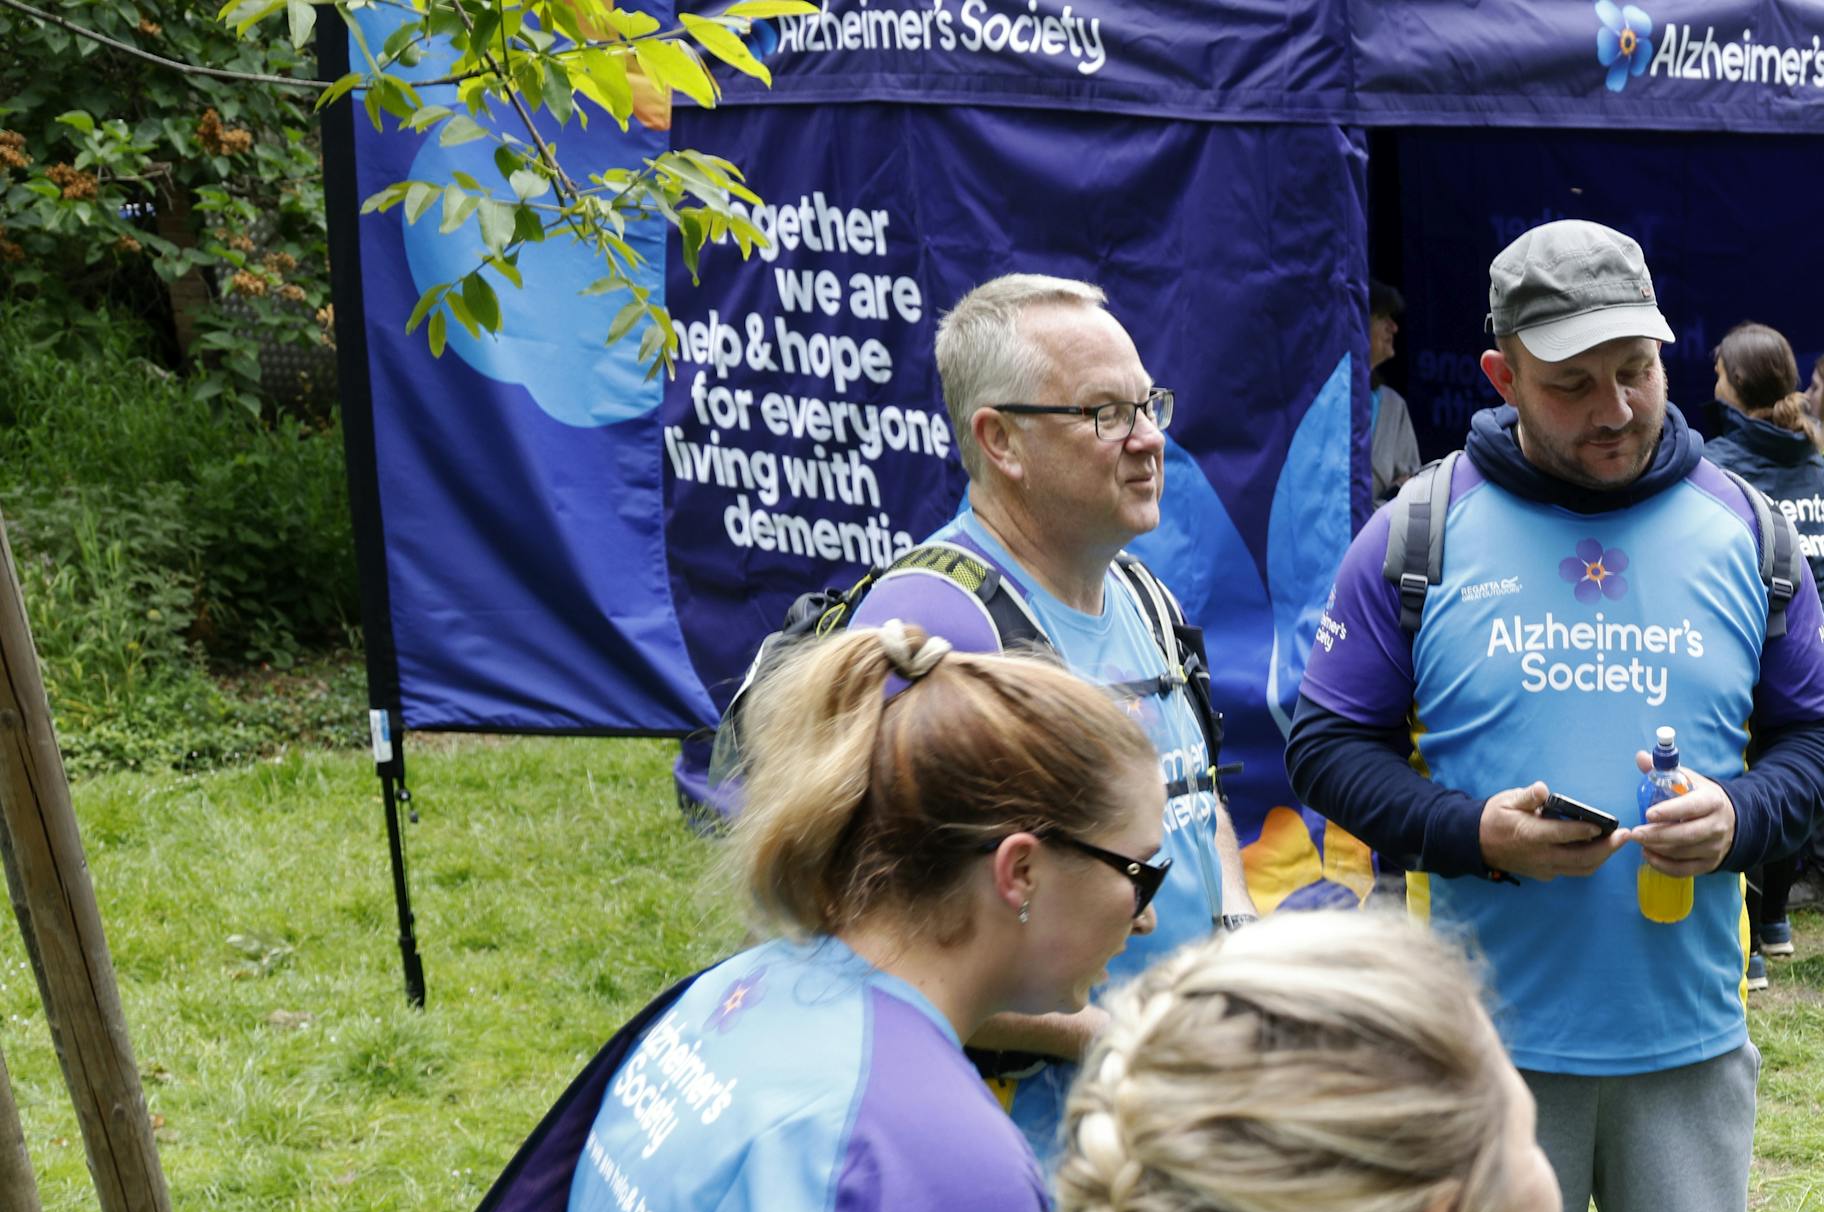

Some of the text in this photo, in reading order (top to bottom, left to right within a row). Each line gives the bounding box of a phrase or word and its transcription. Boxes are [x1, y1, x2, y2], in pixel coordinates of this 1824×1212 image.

[777, 0, 1105, 75] Alzheimer's Society
[775, 268, 922, 323] we are
[746, 313, 779, 372] &
[774, 316, 893, 393] hope
[691, 372, 951, 459] for everyone
[664, 425, 881, 508] living with
[724, 494, 914, 570] dementia
[1487, 612, 1705, 658] Alzheimer's
[1521, 652, 1668, 707] Society
[614, 1053, 679, 1160] Society
